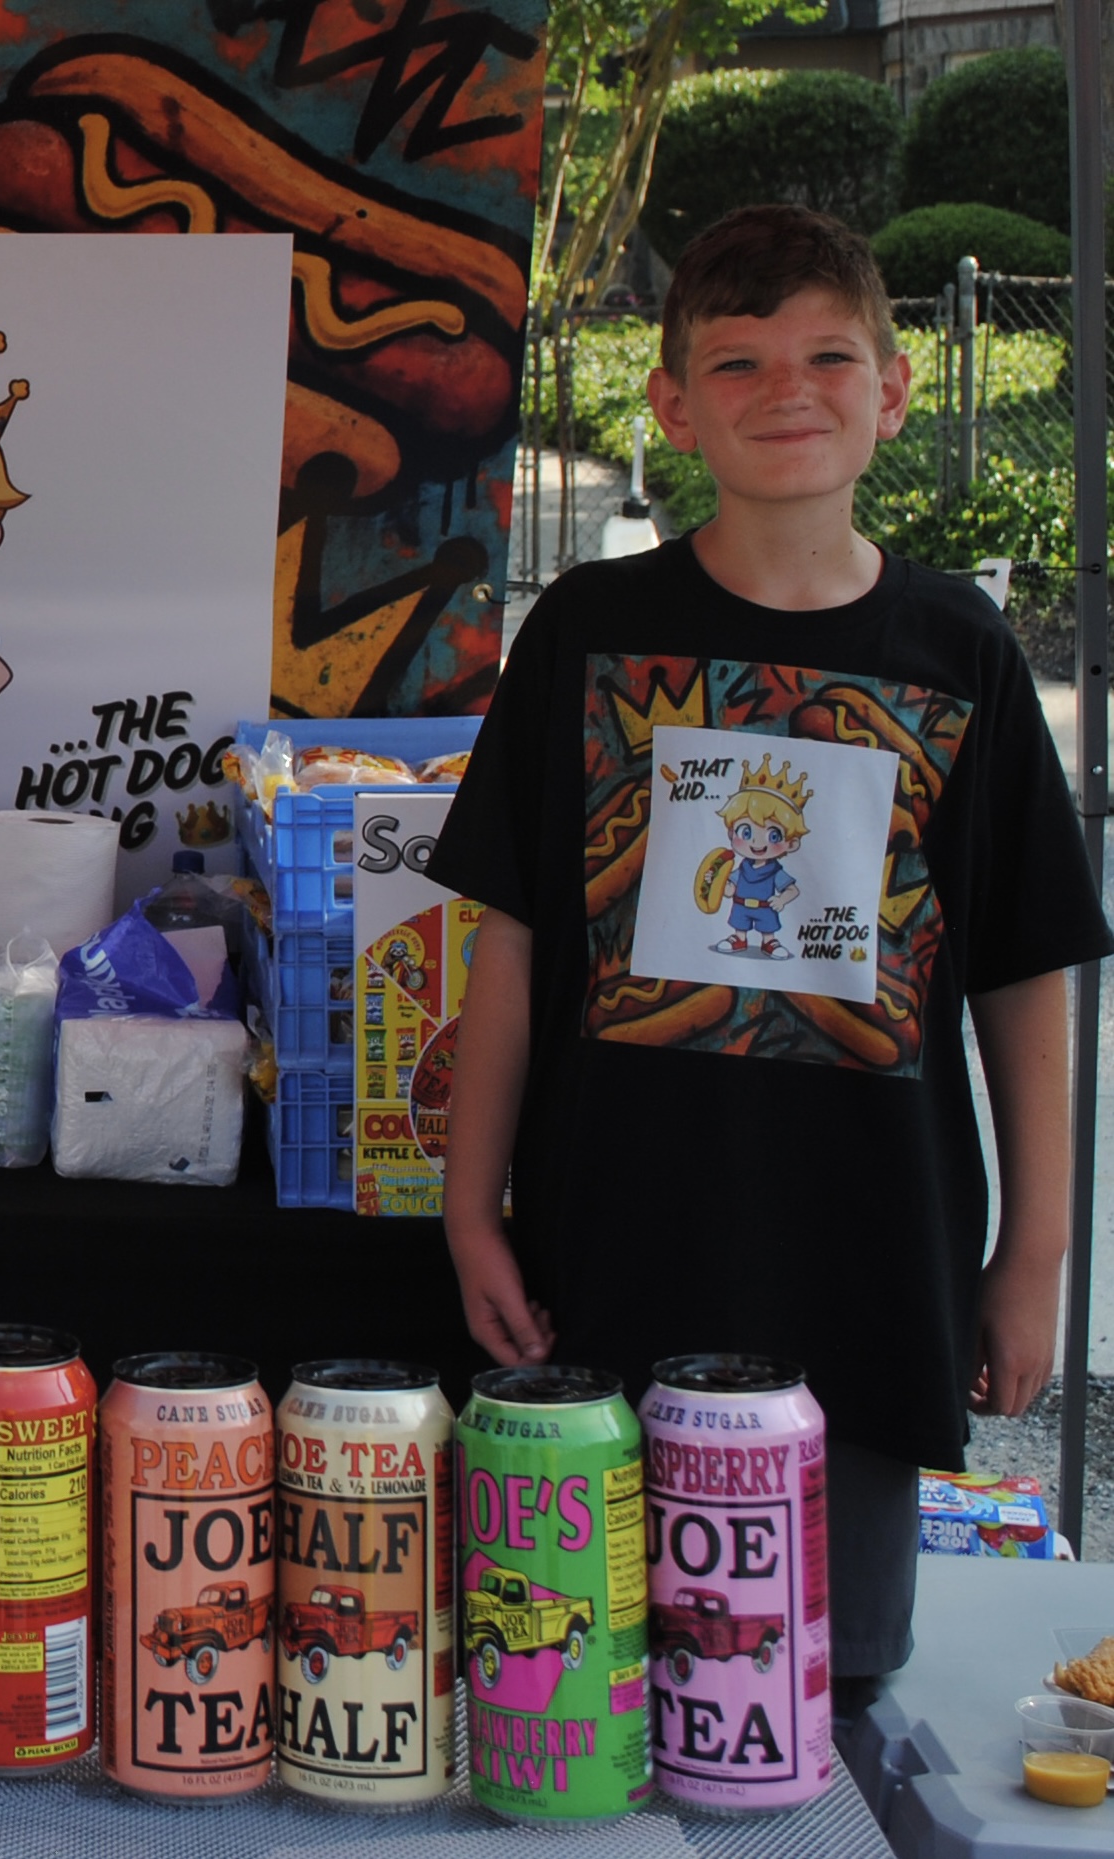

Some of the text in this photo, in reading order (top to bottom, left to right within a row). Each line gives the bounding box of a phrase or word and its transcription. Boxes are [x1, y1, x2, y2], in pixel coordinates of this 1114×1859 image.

[49, 691, 194, 753] ...THE
[14, 736, 236, 811] HOT DOG
[680, 758, 735, 779] THAT
[669, 781, 720, 802] KID...
[357, 815, 438, 874] So
[809, 906, 858, 923] ...THE
[797, 924, 869, 941] HOT DOG
[801, 943, 843, 960] KING
[417, 1115, 448, 1135] HAL
[363, 1147, 409, 1160] KETTLE
[156, 1397, 266, 1422] CANE SUGAR
[333, 1405, 400, 1424] SUGAR
[692, 1410, 762, 1429] SUGAR
[494, 1418, 562, 1439] SUGAR
[7, 1443, 82, 1461] Nutrition Facts
[341, 1442, 427, 1478] TEA
[0, 1474, 87, 1501] Calories 210
[307, 1474, 324, 1491] TEA
[329, 1478, 343, 1493] &
[371, 1478, 427, 1495] LEMONADE
[144, 1498, 273, 1572] JOE
[278, 1500, 419, 1574] HALF
[921, 1519, 978, 1538] JUICE
[647, 1503, 779, 1580] JOE
[927, 1535, 970, 1549] 100%
[507, 1612, 525, 1626] JOE
[508, 1625, 529, 1639] TEA
[144, 1682, 274, 1754] TEA
[277, 1683, 418, 1763] HALF
[652, 1685, 784, 1764] TEA
[183, 1775, 194, 1784] 16
[196, 1775, 206, 1785] FL
[209, 1774, 222, 1784] OZ
[473, 1746, 569, 1792] KIWI
[308, 1774, 318, 1785] FL
[319, 1777, 331, 1787] OZ
[334, 1779, 354, 1790] (473
[356, 1781, 376, 1791] mL)
